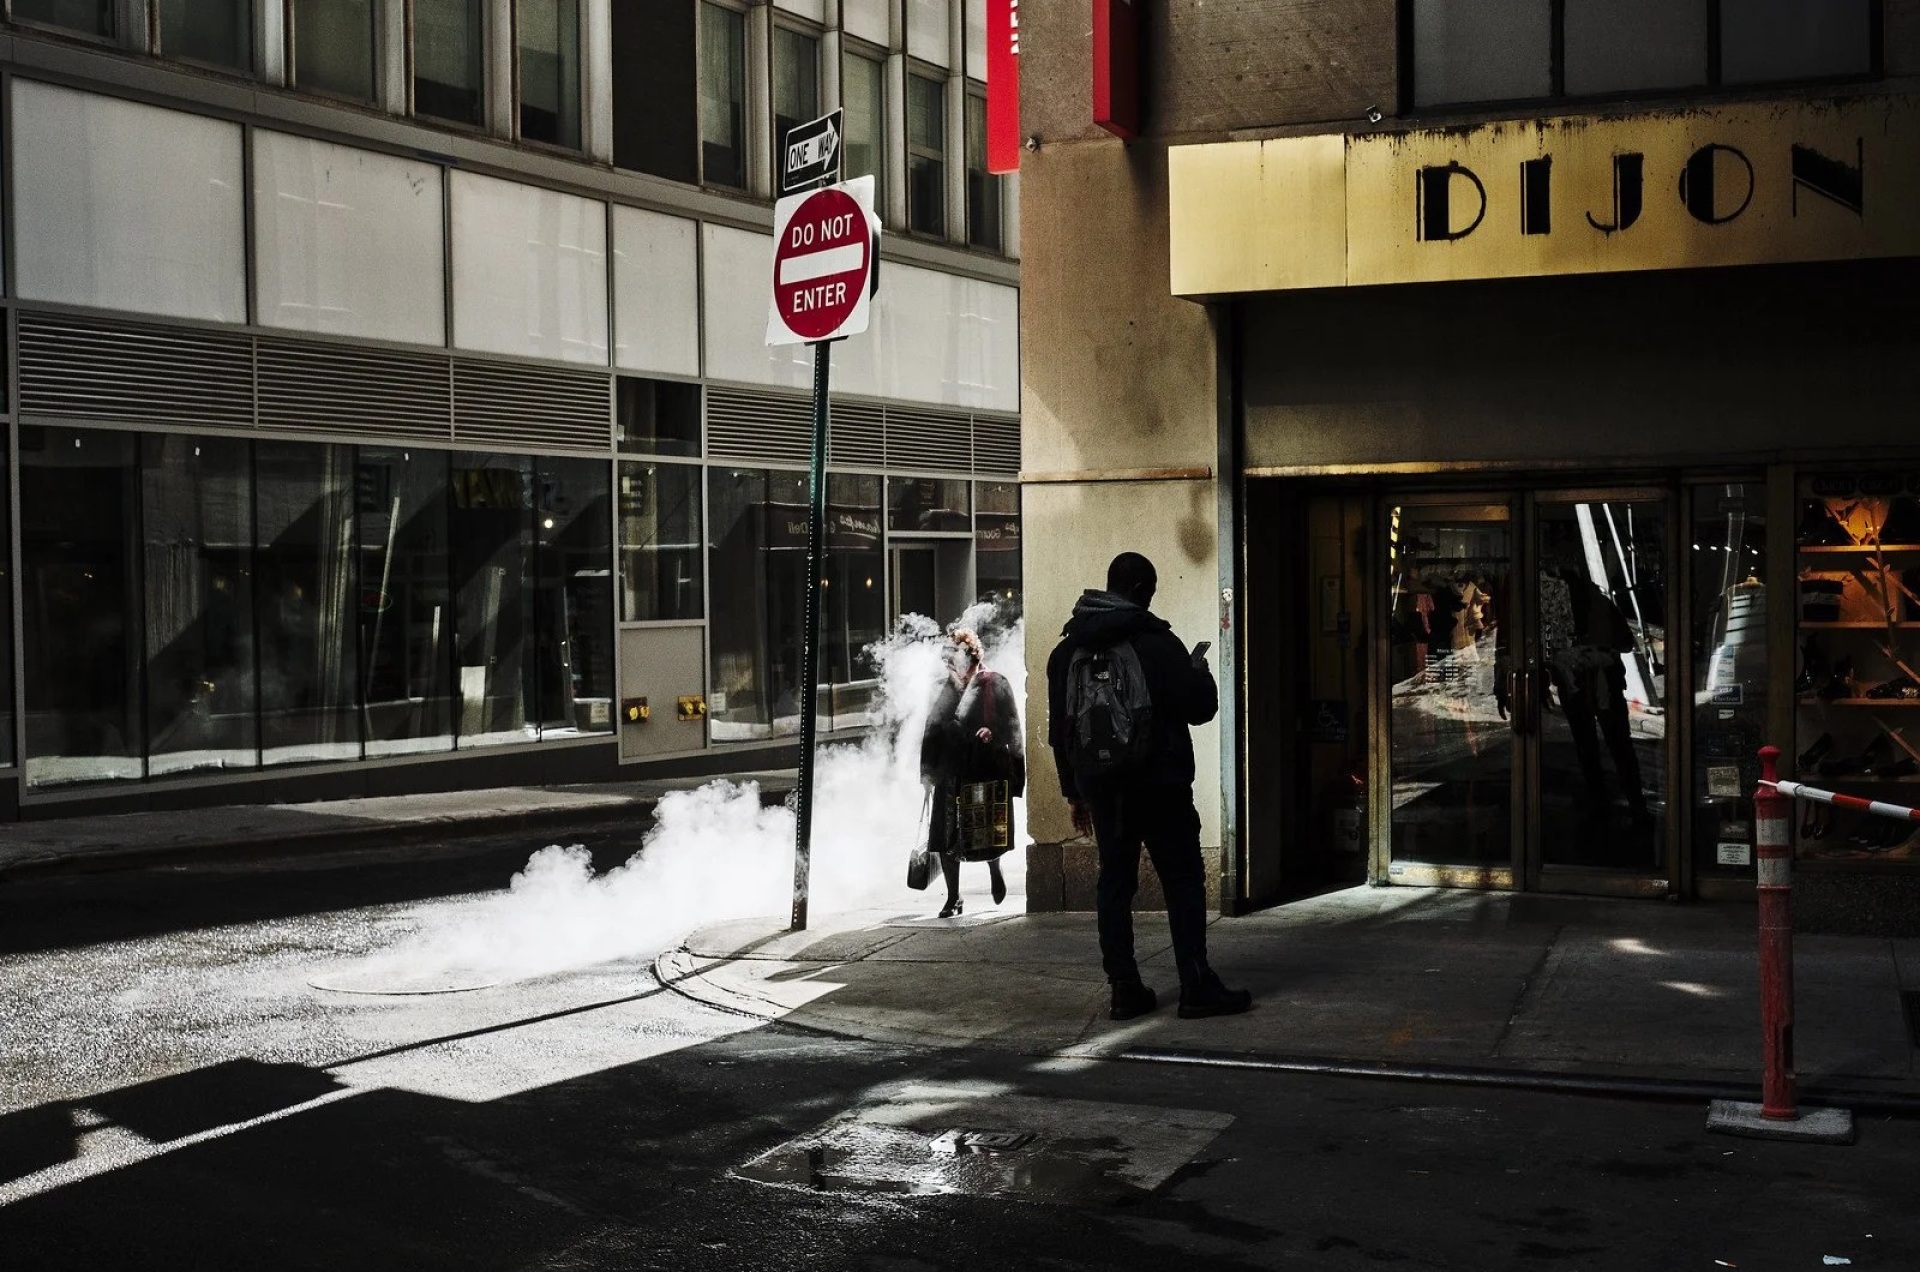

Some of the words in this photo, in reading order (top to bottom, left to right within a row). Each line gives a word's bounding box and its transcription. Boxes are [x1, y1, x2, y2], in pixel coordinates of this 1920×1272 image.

[790, 142, 810, 170] ONE
[817, 131, 835, 160] WAY
[1415, 136, 1864, 243] DIJON
[792, 222, 815, 249] DO
[820, 213, 854, 242] NOT
[793, 281, 847, 313] ENTER
